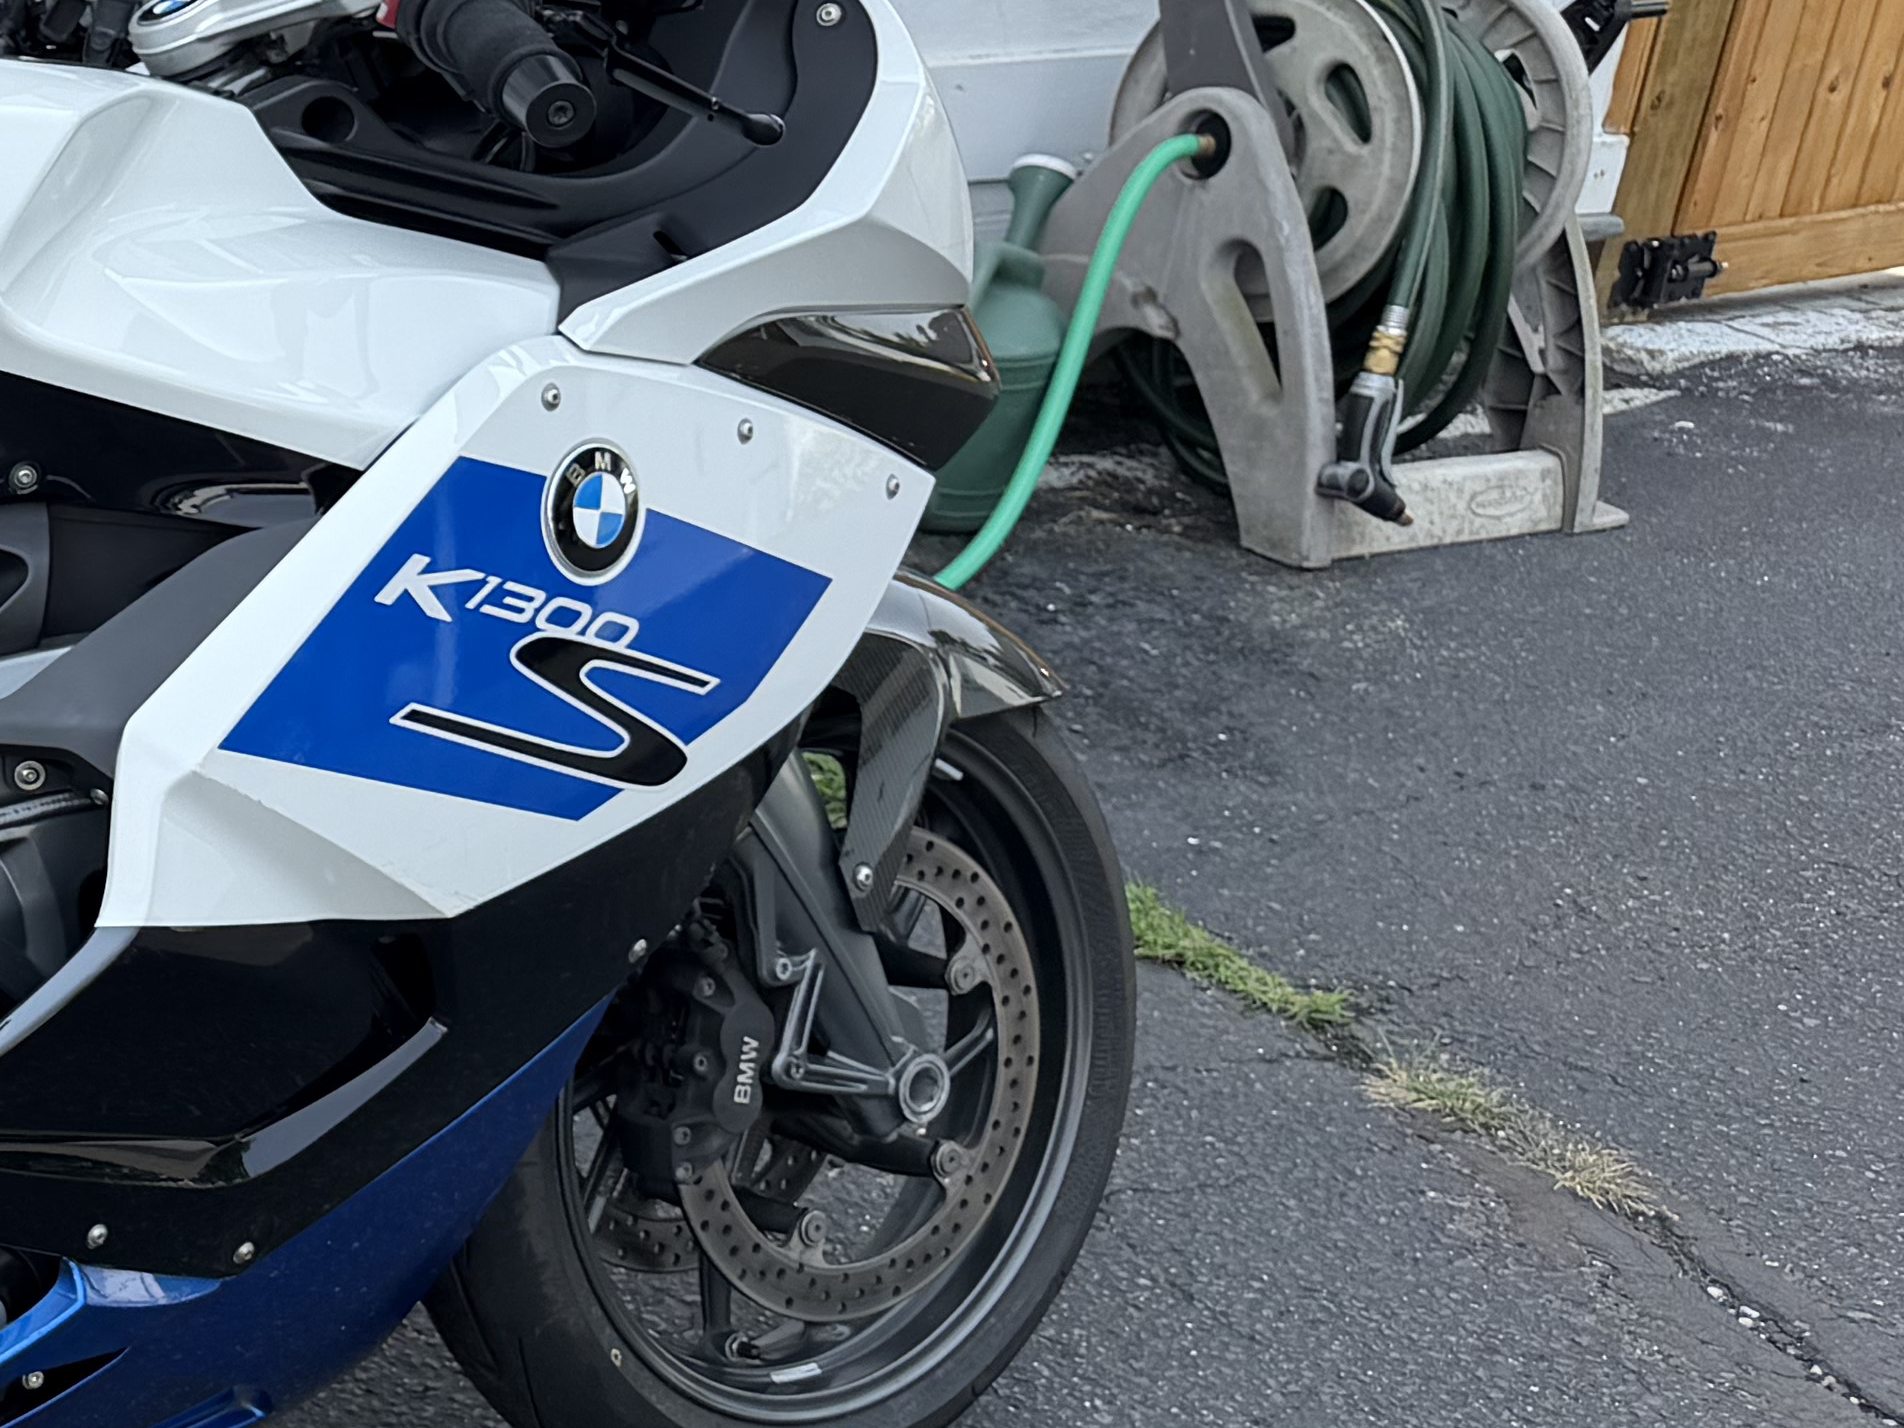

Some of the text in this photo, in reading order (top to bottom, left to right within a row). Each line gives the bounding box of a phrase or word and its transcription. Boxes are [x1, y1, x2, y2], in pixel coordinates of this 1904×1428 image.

[567, 452, 636, 494] BMW
[389, 631, 721, 786] S
[733, 1035, 760, 1105] BMW
